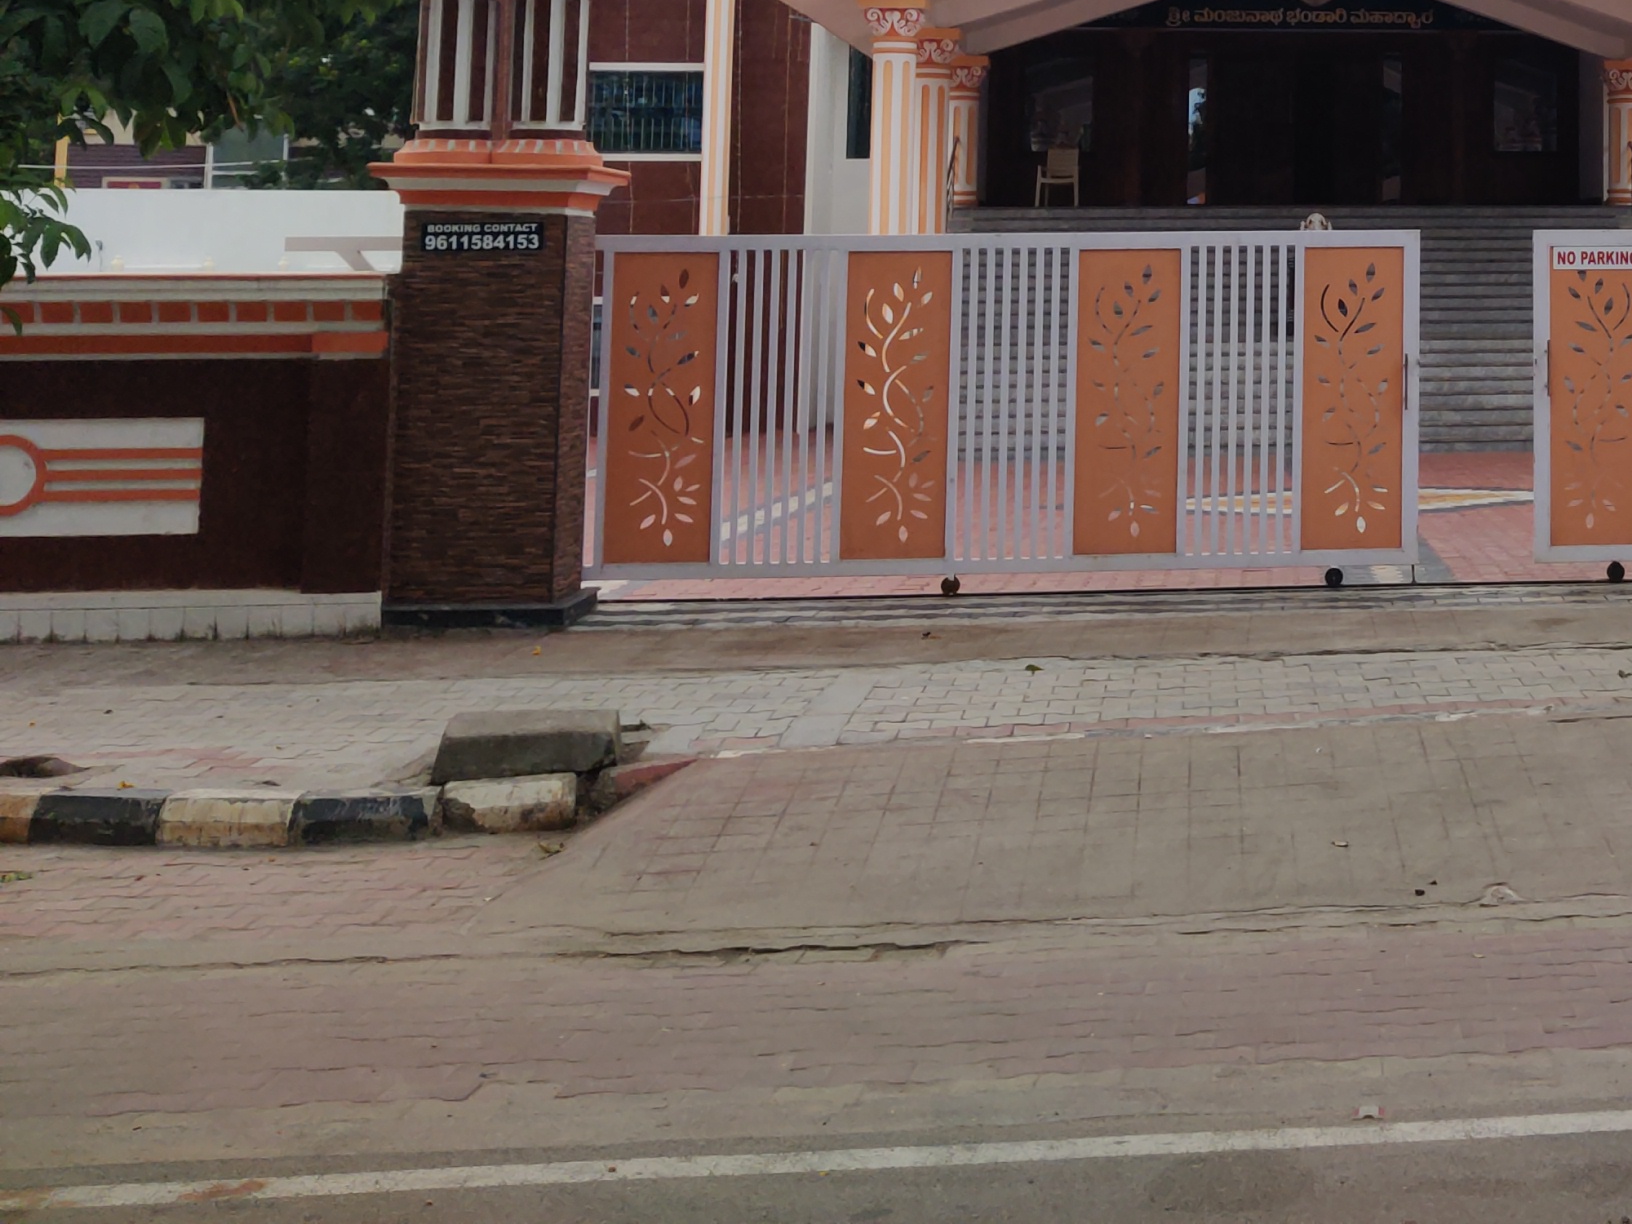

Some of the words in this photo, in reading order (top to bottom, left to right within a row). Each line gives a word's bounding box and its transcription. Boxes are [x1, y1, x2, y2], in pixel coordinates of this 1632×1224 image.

[427, 224, 481, 233] BOOKING
[484, 223, 538, 232] CONTACT
[424, 234, 539, 250] 9611584153
[1557, 251, 1576, 265] NO
